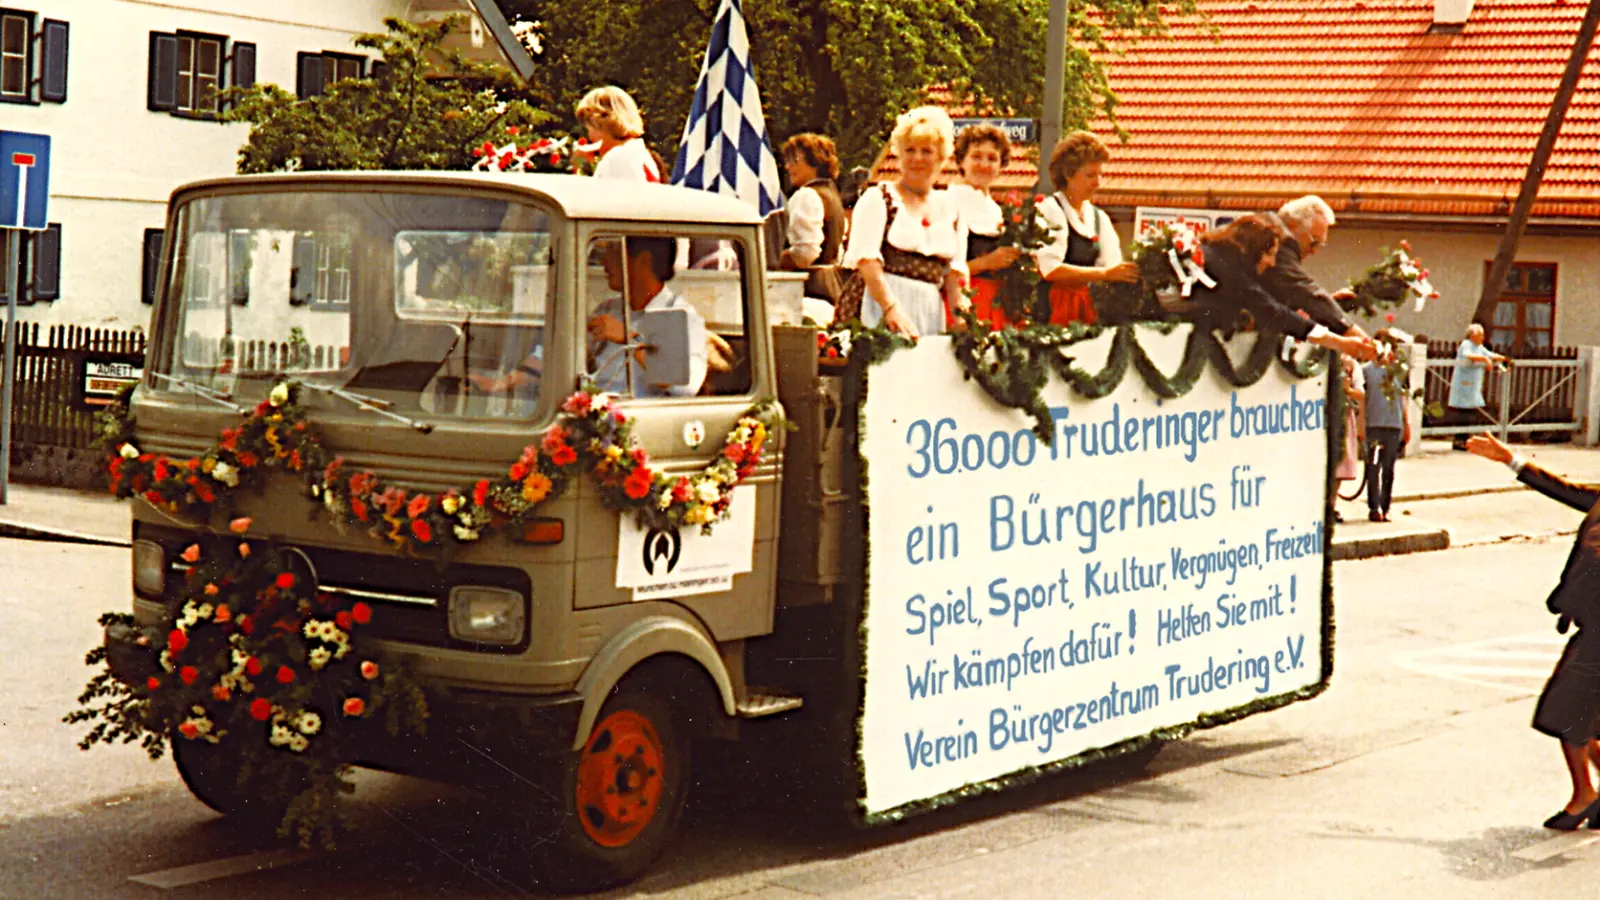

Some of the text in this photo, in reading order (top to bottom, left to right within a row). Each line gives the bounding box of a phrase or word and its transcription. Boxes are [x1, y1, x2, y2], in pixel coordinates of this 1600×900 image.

[906, 418, 1037, 479] 36.000
[1048, 404, 1225, 463] Truderinger
[906, 465, 1266, 565] ein Bürgerhaus für
[906, 586, 983, 645] Spiel,
[987, 567, 1076, 627] Sport,
[1085, 556, 1168, 600] Kultur,
[1170, 538, 1263, 590] Vergnügen,
[905, 659, 949, 701] Wir
[953, 636, 1055, 692] kämpfen
[1157, 603, 1212, 648] Helfen
[1215, 593, 1248, 629] Sie
[903, 634, 1306, 770] Verein Bürgerzentrum Trudering e.V.
